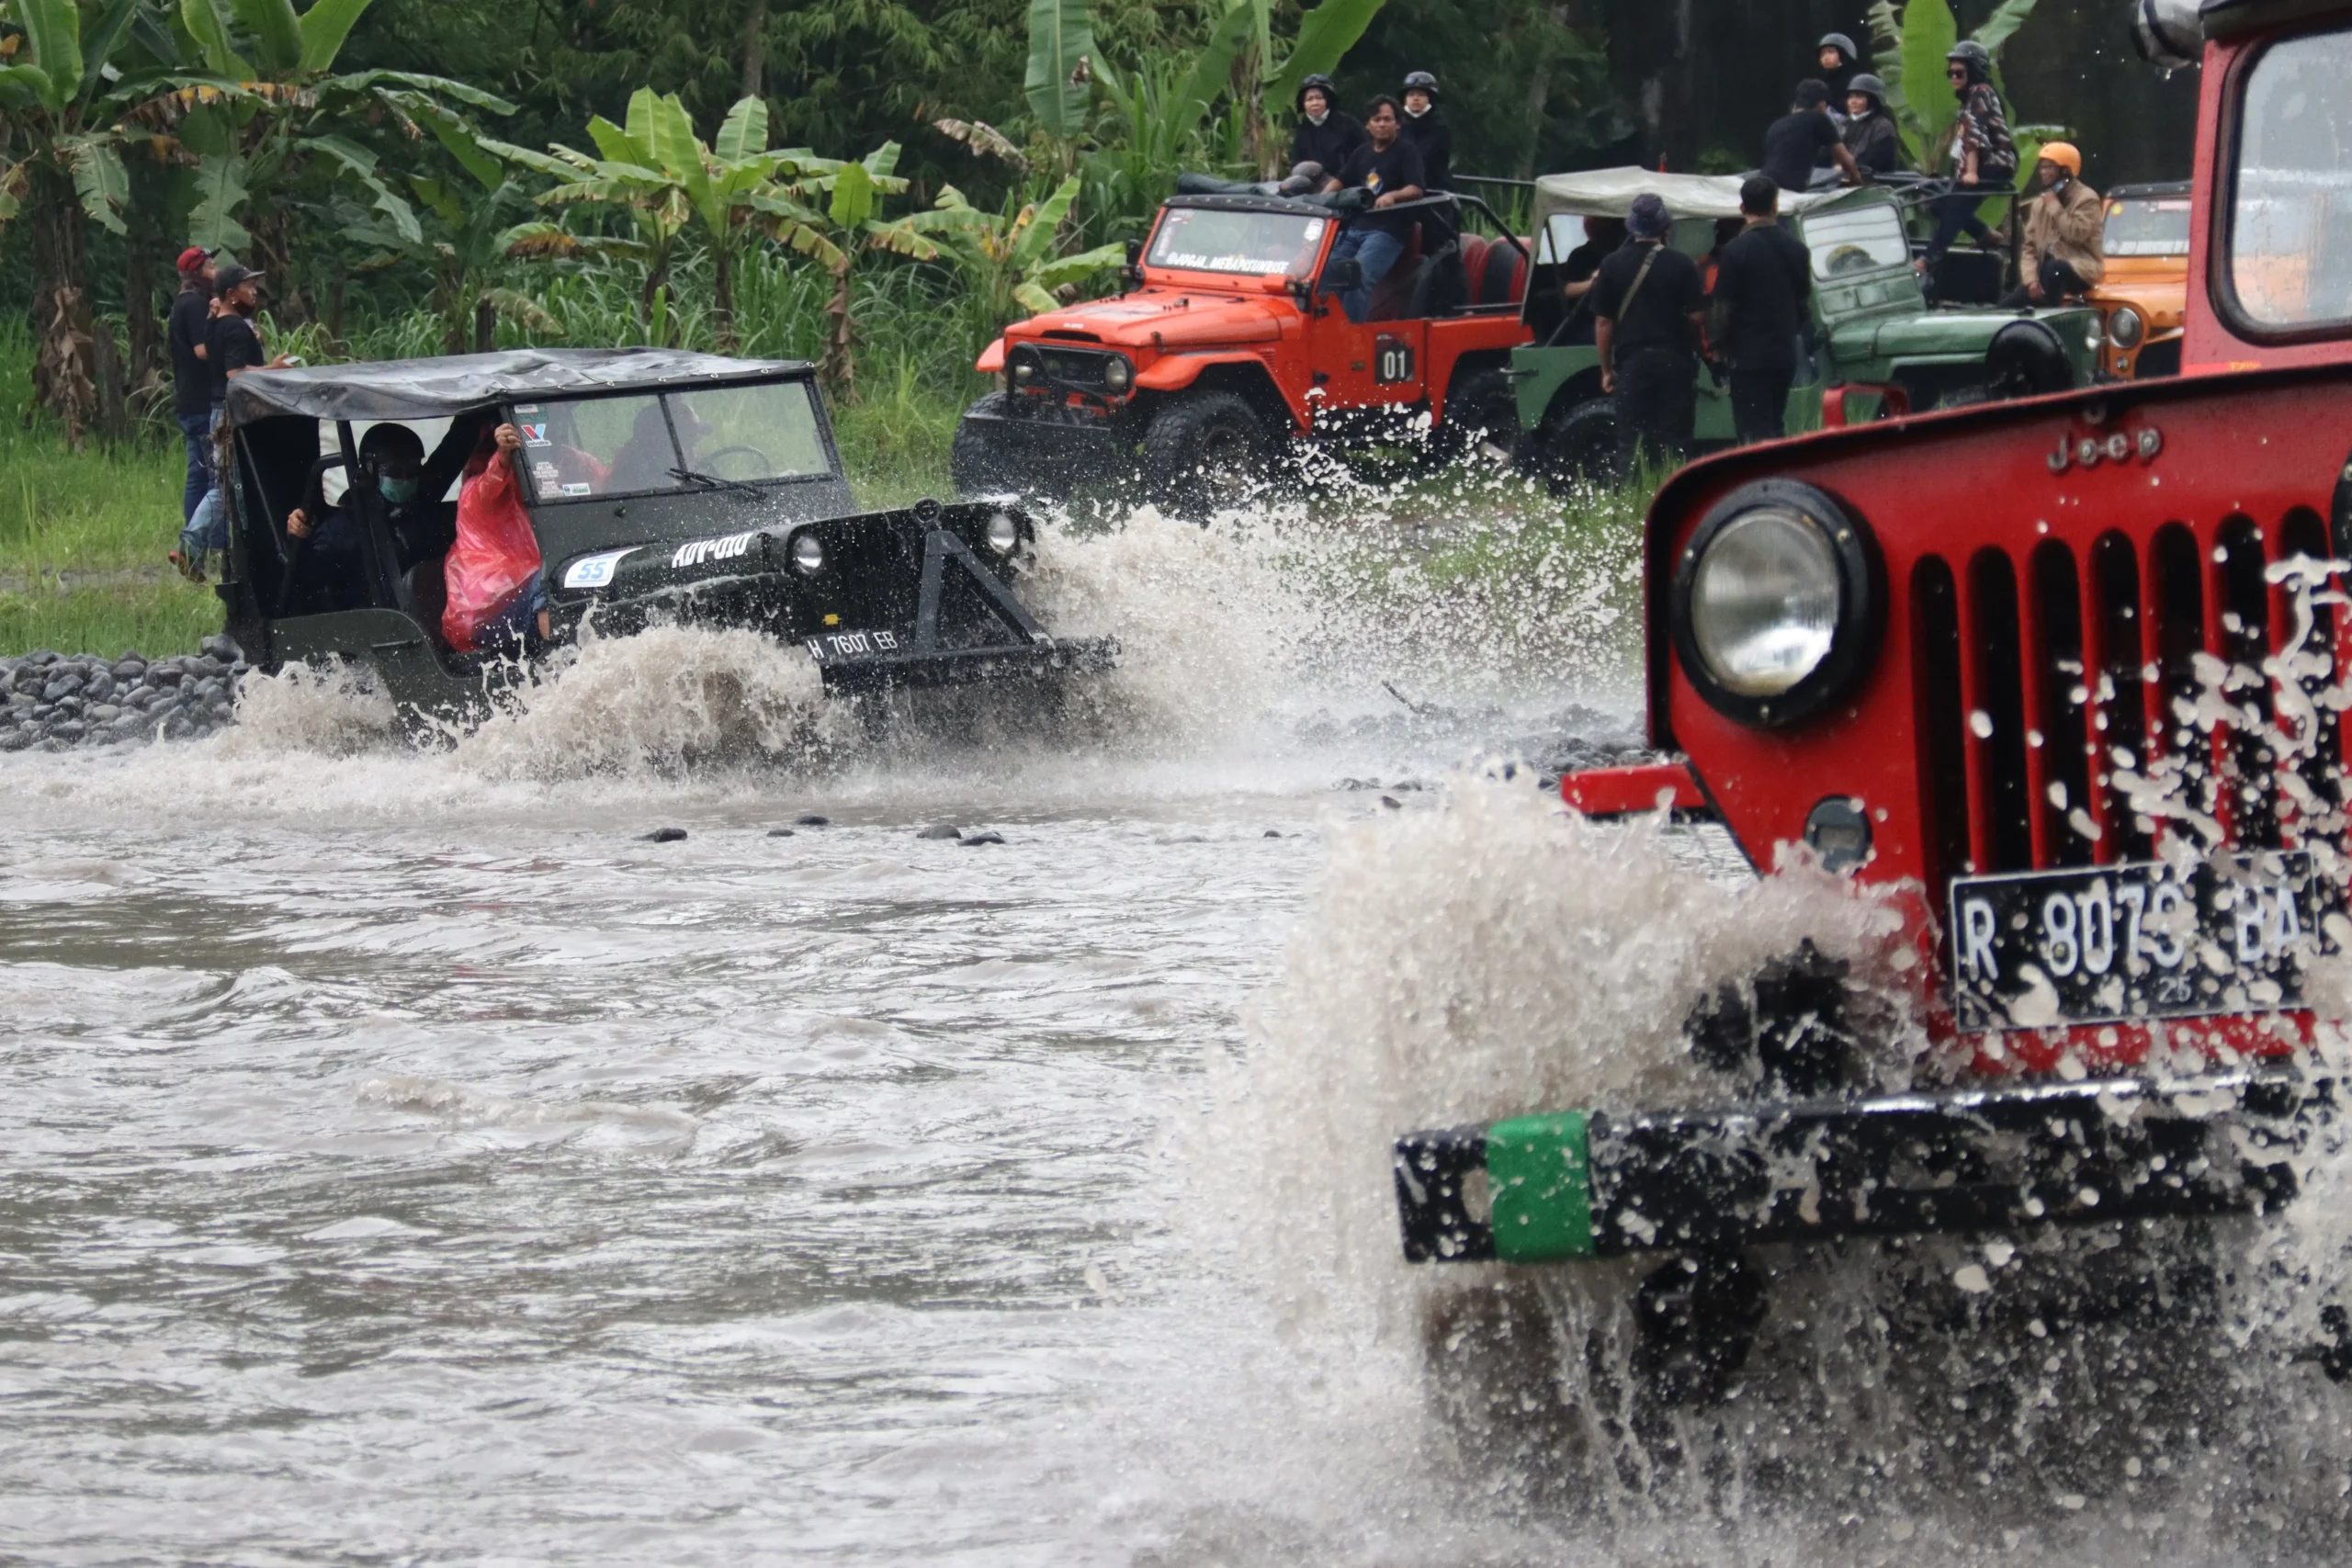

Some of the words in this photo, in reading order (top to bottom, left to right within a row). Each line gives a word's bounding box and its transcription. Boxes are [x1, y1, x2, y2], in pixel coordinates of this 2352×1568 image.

[1384, 351, 1406, 379] 01
[2046, 428, 2160, 470] Jeep
[577, 561, 606, 580] 55
[807, 639, 825, 660] H
[827, 633, 871, 656] 7607
[873, 631, 899, 650] EB
[1962, 897, 1999, 981] R
[2157, 976, 2193, 1004] 25
